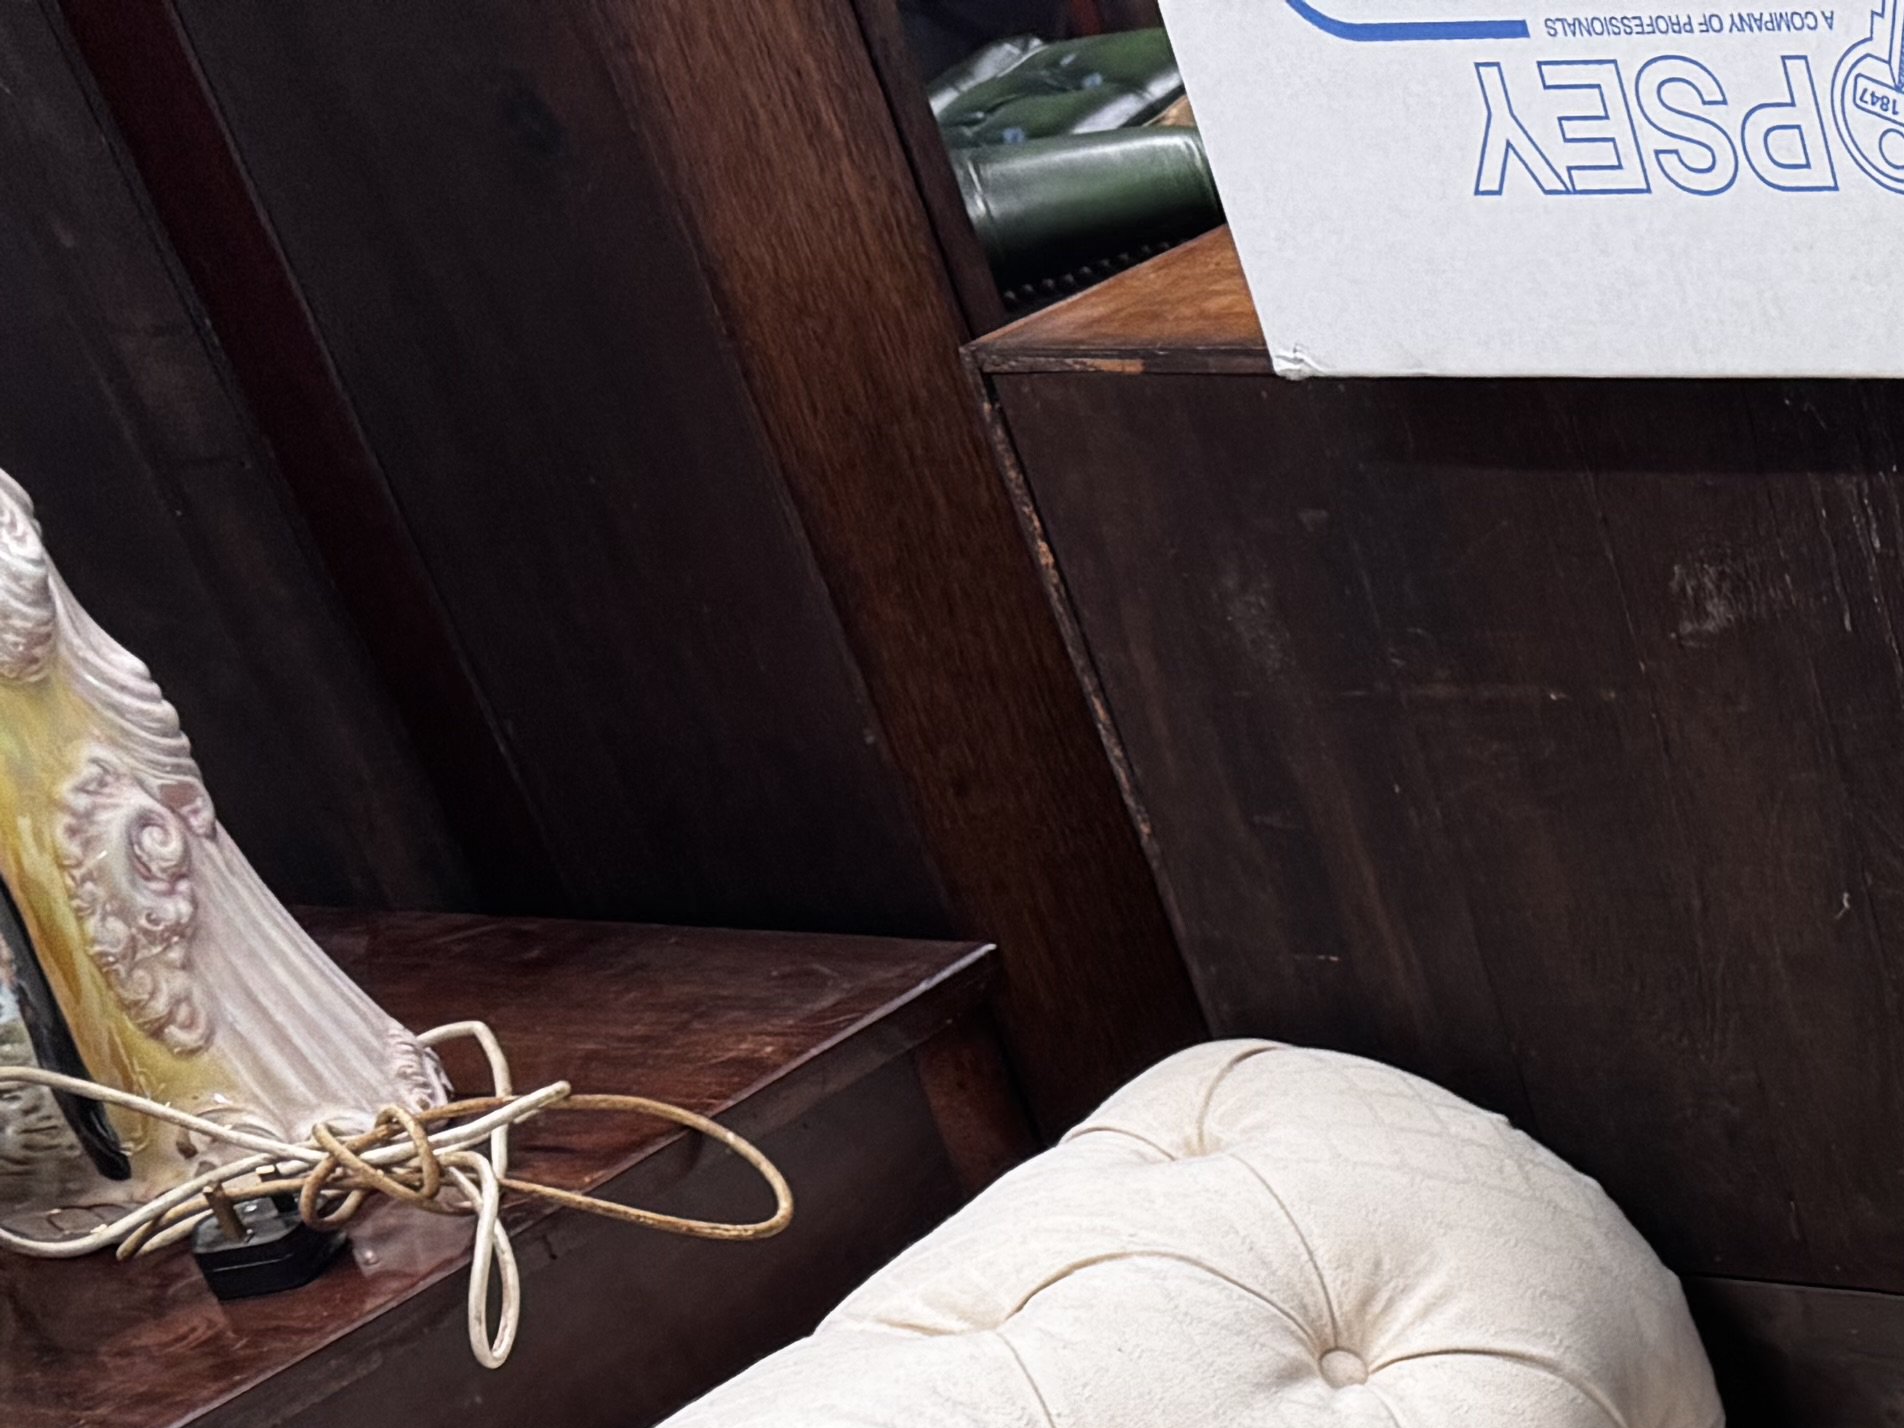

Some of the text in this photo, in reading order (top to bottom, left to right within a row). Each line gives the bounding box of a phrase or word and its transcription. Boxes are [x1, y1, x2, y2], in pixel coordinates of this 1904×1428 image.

[1544, 9, 1835, 37] A COMPANY OF PROFESSIONALS
[1859, 87, 1900, 116] 1847
